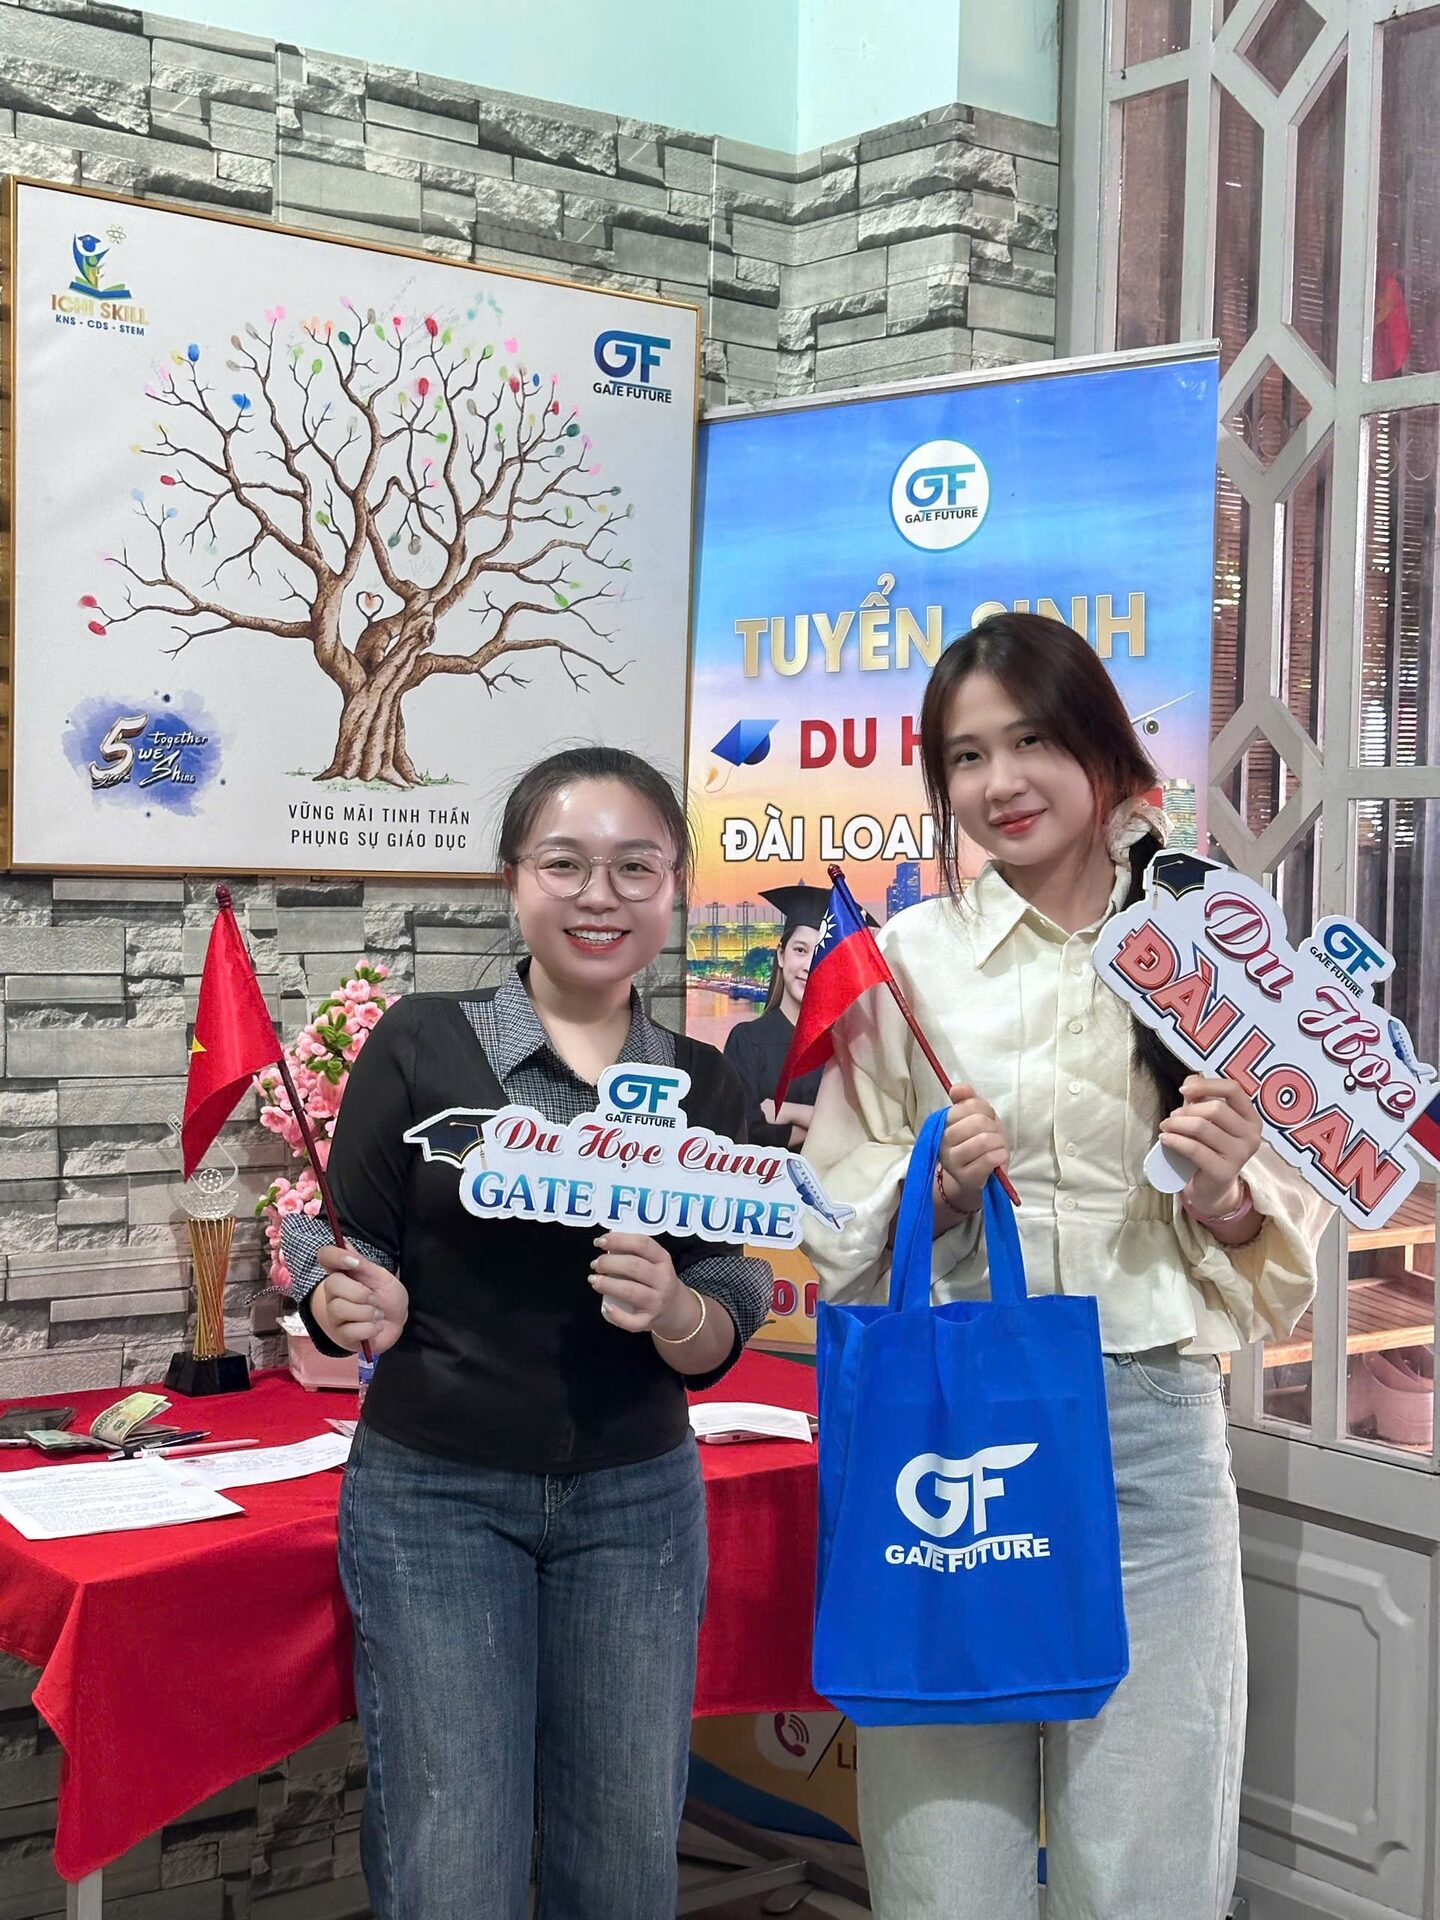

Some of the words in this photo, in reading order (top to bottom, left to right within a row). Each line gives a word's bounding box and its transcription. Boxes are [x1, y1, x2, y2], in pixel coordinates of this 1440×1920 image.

[55, 314, 76, 325] KNS
[87, 319, 109, 330] CDS
[119, 324, 145, 336] STEM
[100, 301, 149, 326] SKILL
[594, 330, 671, 383] GF
[593, 380, 624, 396] GATE
[626, 386, 672, 403] FUTURE
[905, 463, 976, 507] GF
[905, 510, 932, 524] GATE
[934, 507, 978, 520] FUTURE
[735, 573, 942, 678] TUYỂN
[90, 713, 149, 780] 5
[149, 731, 208, 749] together
[800, 717, 877, 769] DU
[139, 750, 197, 786] Shine
[288, 801, 334, 821] VỮNG
[344, 803, 373, 822] MÃI
[382, 808, 420, 824] TINH
[721, 803, 805, 862] ĐÀI
[291, 829, 349, 848] PHỤNG
[358, 831, 379, 850] SỰ
[387, 829, 426, 848] GIÁO
[435, 834, 467, 851] DỤC
[1205, 891, 1294, 1000] Du
[1323, 923, 1386, 976] GF
[1310, 946, 1332, 969] GATE
[1329, 966, 1363, 999] FUTURE
[1110, 919, 1245, 1061] ĐÀI
[1216, 1025, 1406, 1217] LOAN
[1298, 986, 1416, 1119] Học
[605, 1110, 633, 1124] GATE
[635, 1115, 676, 1129] FUTURE
[609, 1073, 679, 1114] GF
[495, 1116, 561, 1153] Du
[578, 1124, 663, 1169] Học
[678, 1136, 784, 1185] Cùng
[471, 1170, 594, 1217] GATE
[607, 1184, 796, 1239] FUTURE
[896, 1442, 1039, 1538] GF
[885, 1540, 945, 1573] GATE
[949, 1537, 1051, 1573] FUTURE
